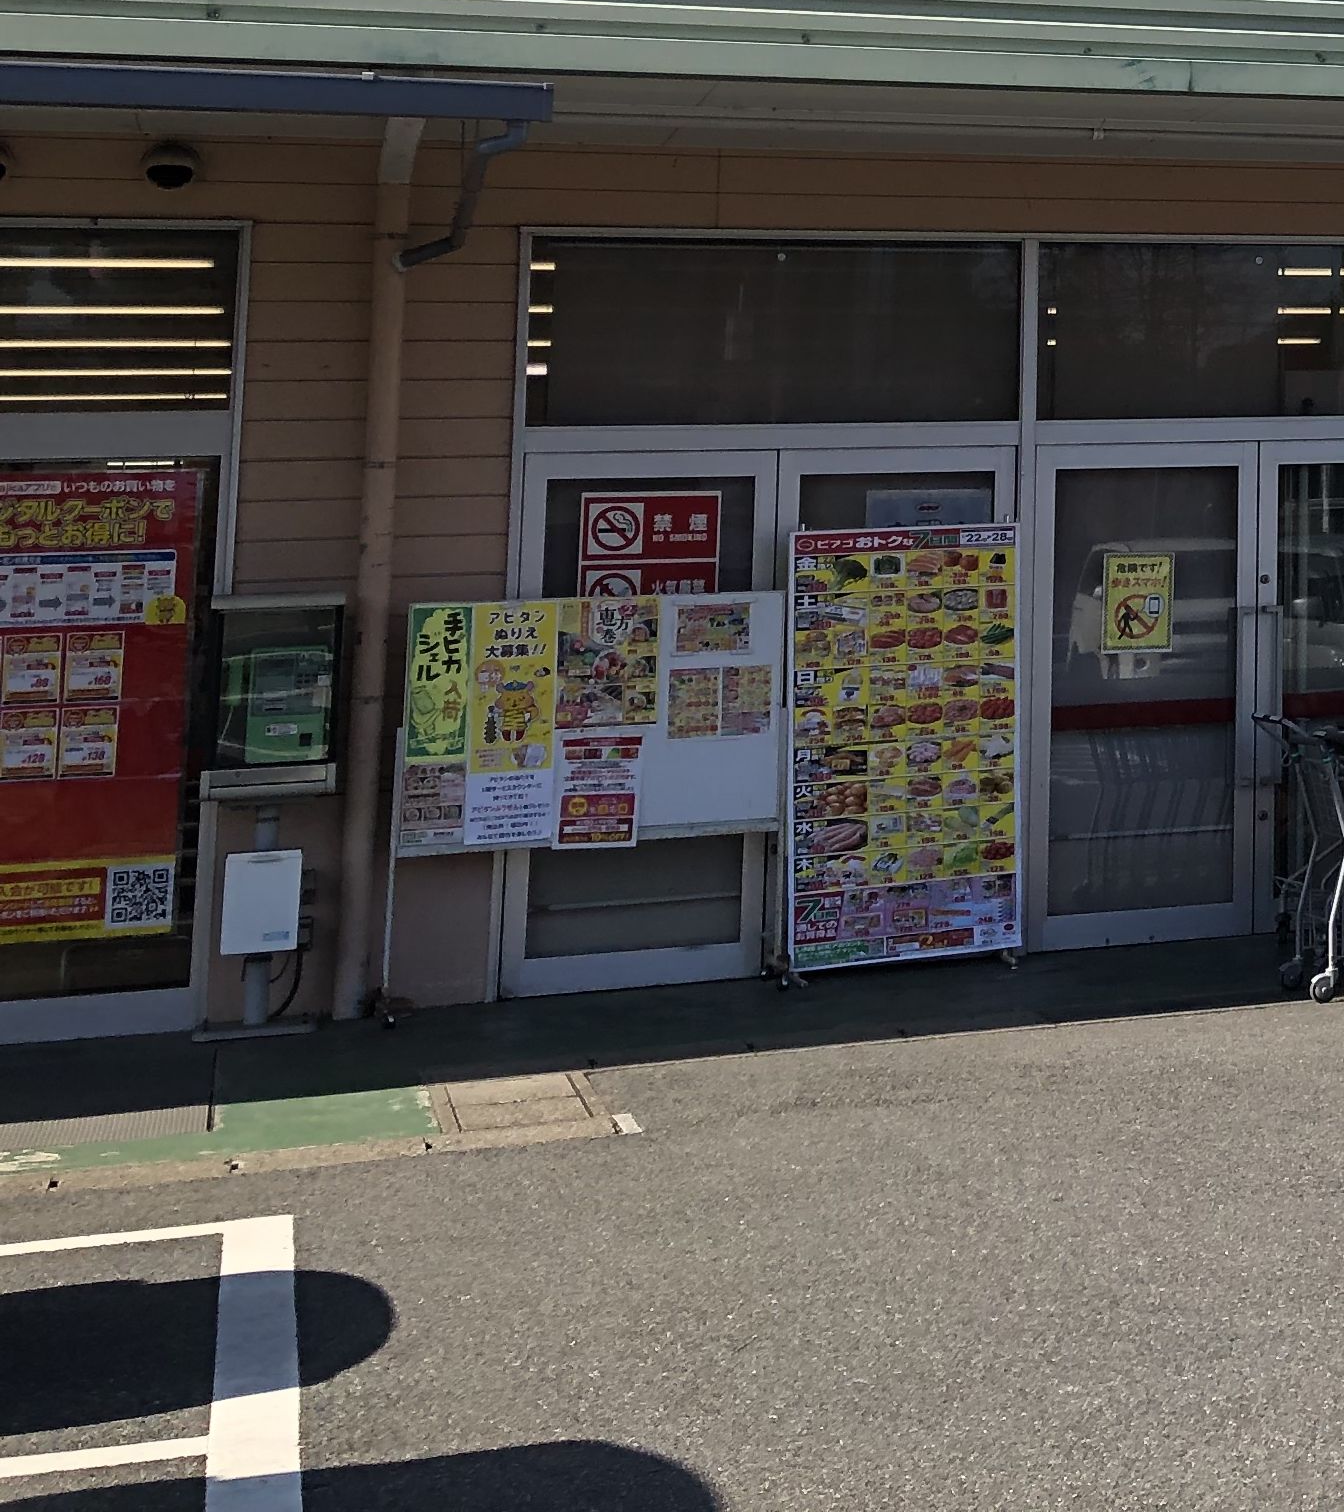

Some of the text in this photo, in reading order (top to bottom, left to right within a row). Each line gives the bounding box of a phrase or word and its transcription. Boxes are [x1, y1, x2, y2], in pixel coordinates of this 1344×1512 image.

[63, 479, 176, 493] いつものお買い物を
[1116, 562, 1162, 574] 危険です!
[494, 626, 538, 641] ぬりえ
